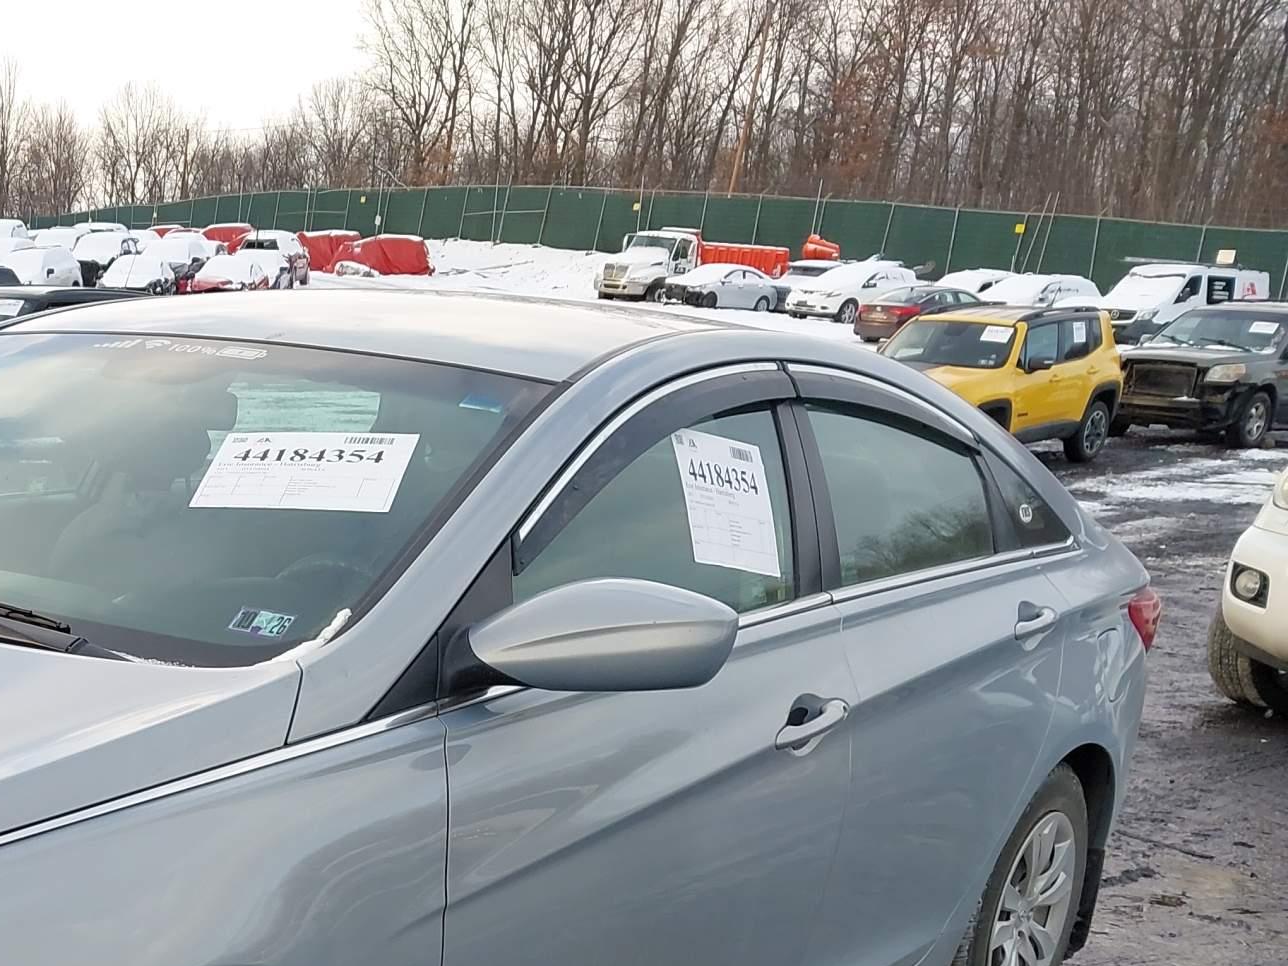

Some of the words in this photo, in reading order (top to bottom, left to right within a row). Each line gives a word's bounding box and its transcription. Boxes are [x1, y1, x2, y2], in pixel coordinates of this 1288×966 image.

[168, 343, 217, 356] 100%
[233, 448, 385, 464] 44184354
[688, 458, 759, 495] 44184354
[269, 616, 292, 635] 26
